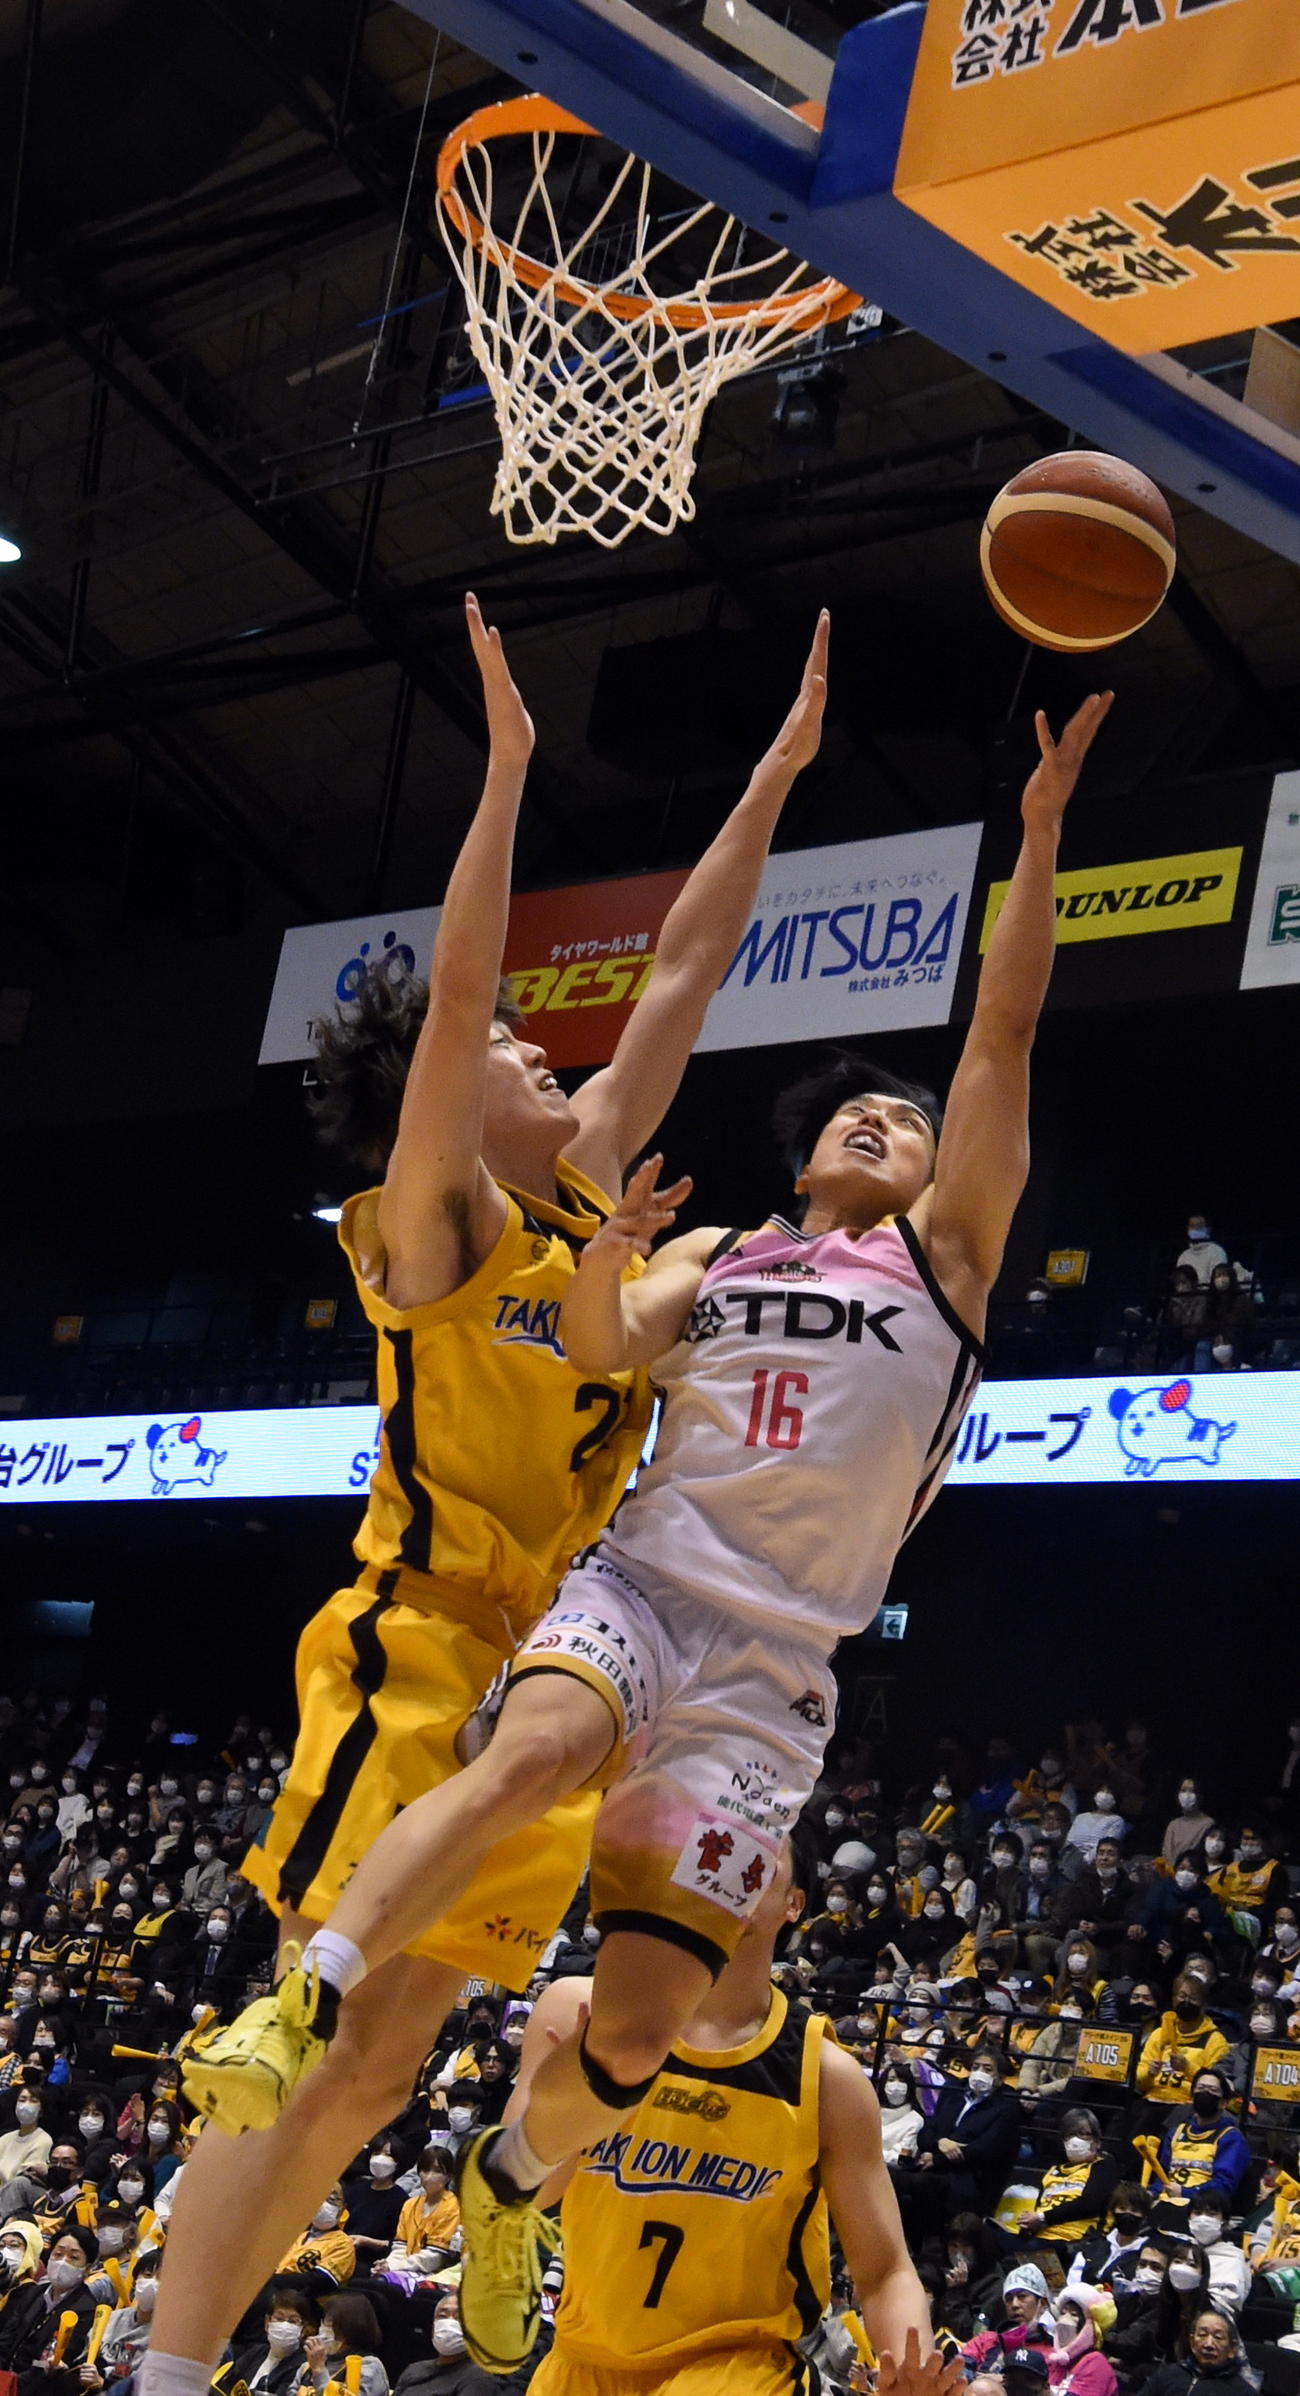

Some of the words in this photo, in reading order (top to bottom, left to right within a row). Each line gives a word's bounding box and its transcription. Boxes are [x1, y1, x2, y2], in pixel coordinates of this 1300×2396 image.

[955, 17, 1046, 84] 会社
[716, 892, 960, 990] MITSUBA
[726, 1291, 906, 1354] TDK
[744, 1368, 809, 1451] 16
[460, 1978, 486, 1998] 105
[1084, 2041, 1121, 2067] A105
[1263, 2061, 1300, 2088] A104
[637, 2220, 685, 2309] 7
